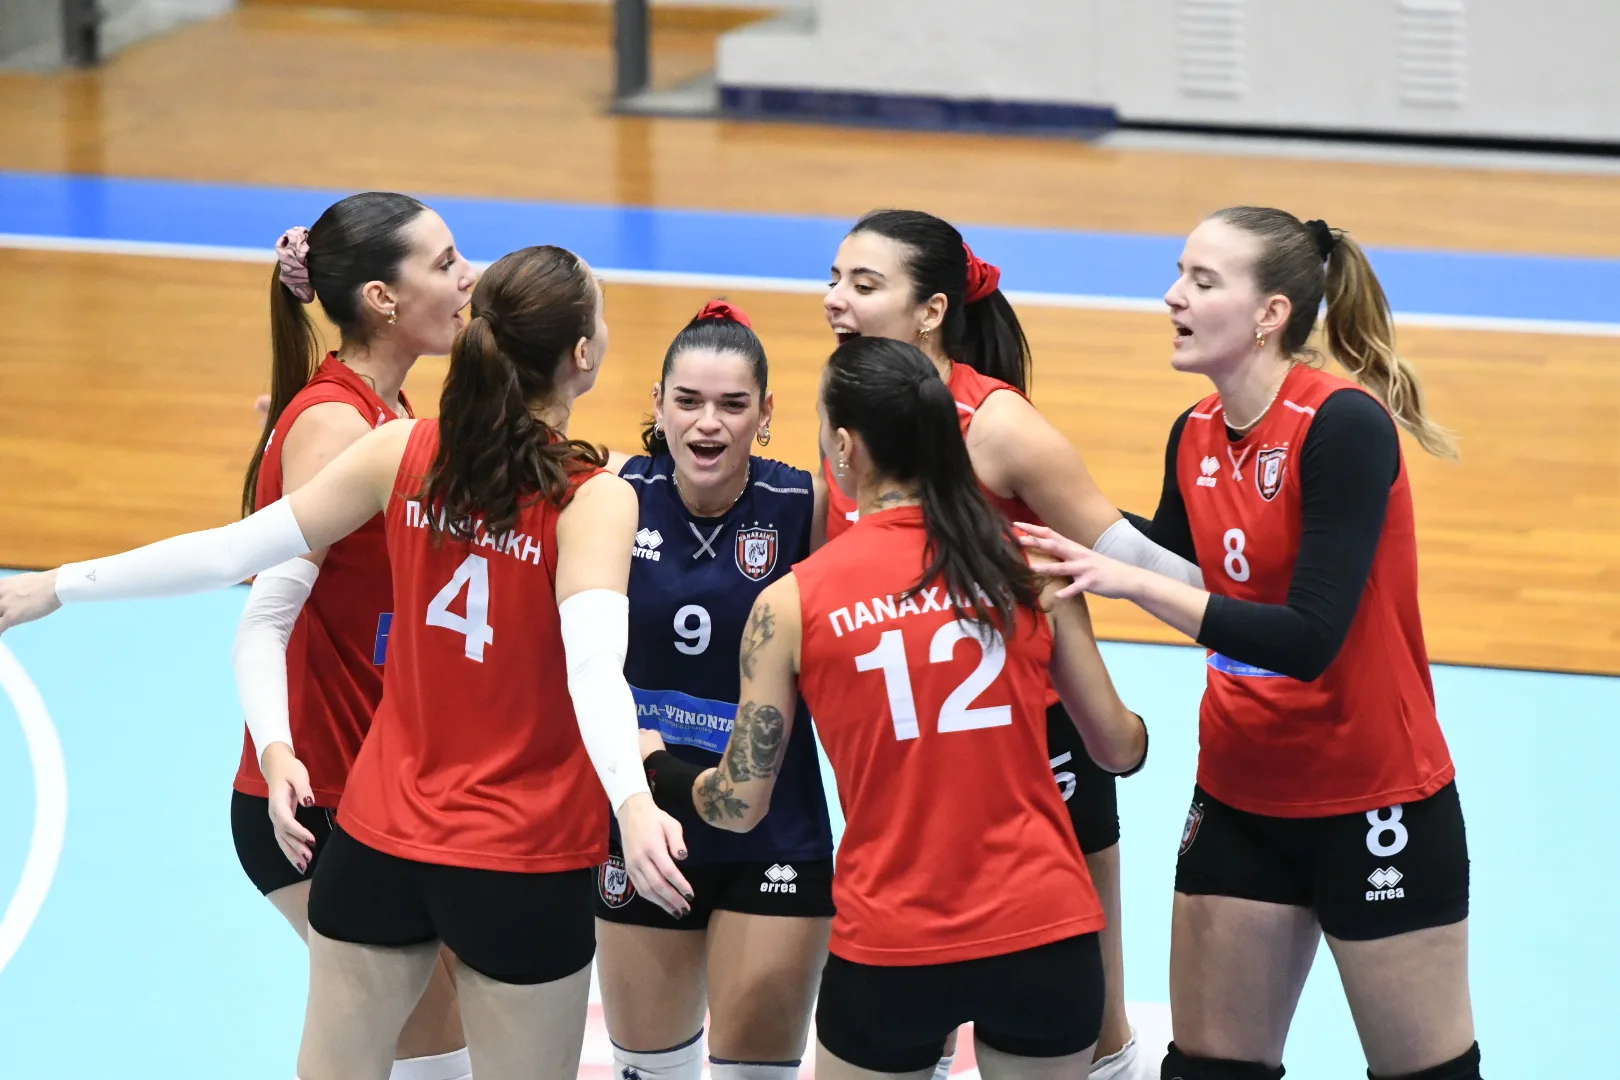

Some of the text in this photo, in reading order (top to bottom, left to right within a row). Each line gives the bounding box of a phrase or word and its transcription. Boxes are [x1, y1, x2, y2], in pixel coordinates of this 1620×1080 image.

[632, 547, 661, 561] errea
[1222, 527, 1250, 582] 8
[425, 552, 494, 663] 4
[673, 604, 712, 655] 9
[854, 618, 1012, 742] 12
[635, 703, 735, 733] ΛΑ-ΨΗΝΟΝΤΑ
[1365, 803, 1409, 857] 8
[760, 881, 797, 893] errea
[1365, 886, 1405, 901] errea
